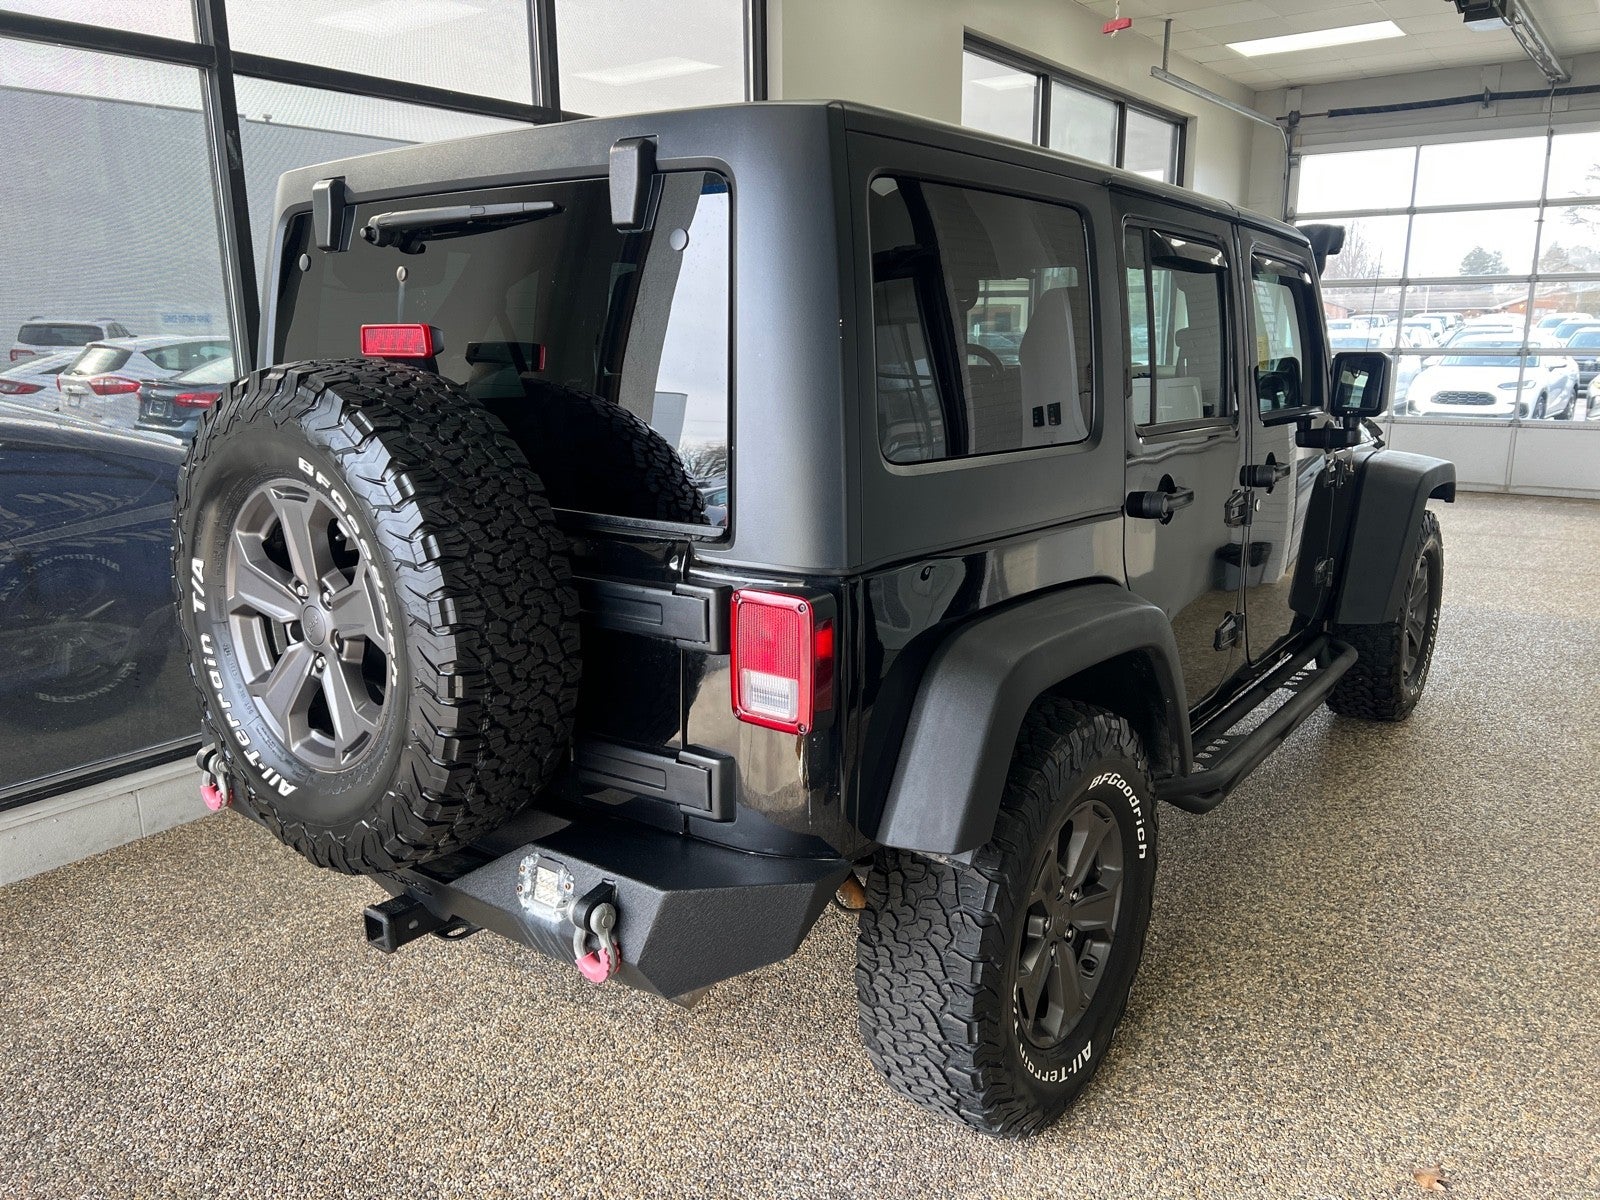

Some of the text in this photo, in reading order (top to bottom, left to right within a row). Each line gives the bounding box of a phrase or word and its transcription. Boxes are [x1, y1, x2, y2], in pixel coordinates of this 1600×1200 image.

[191, 557, 206, 613] T/A
[298, 456, 399, 688] BFGoodrich
[200, 634, 298, 797] All-Terrain
[1087, 772, 1148, 860] BFGoodrich
[1019, 1040, 1092, 1083] All-Terrain
